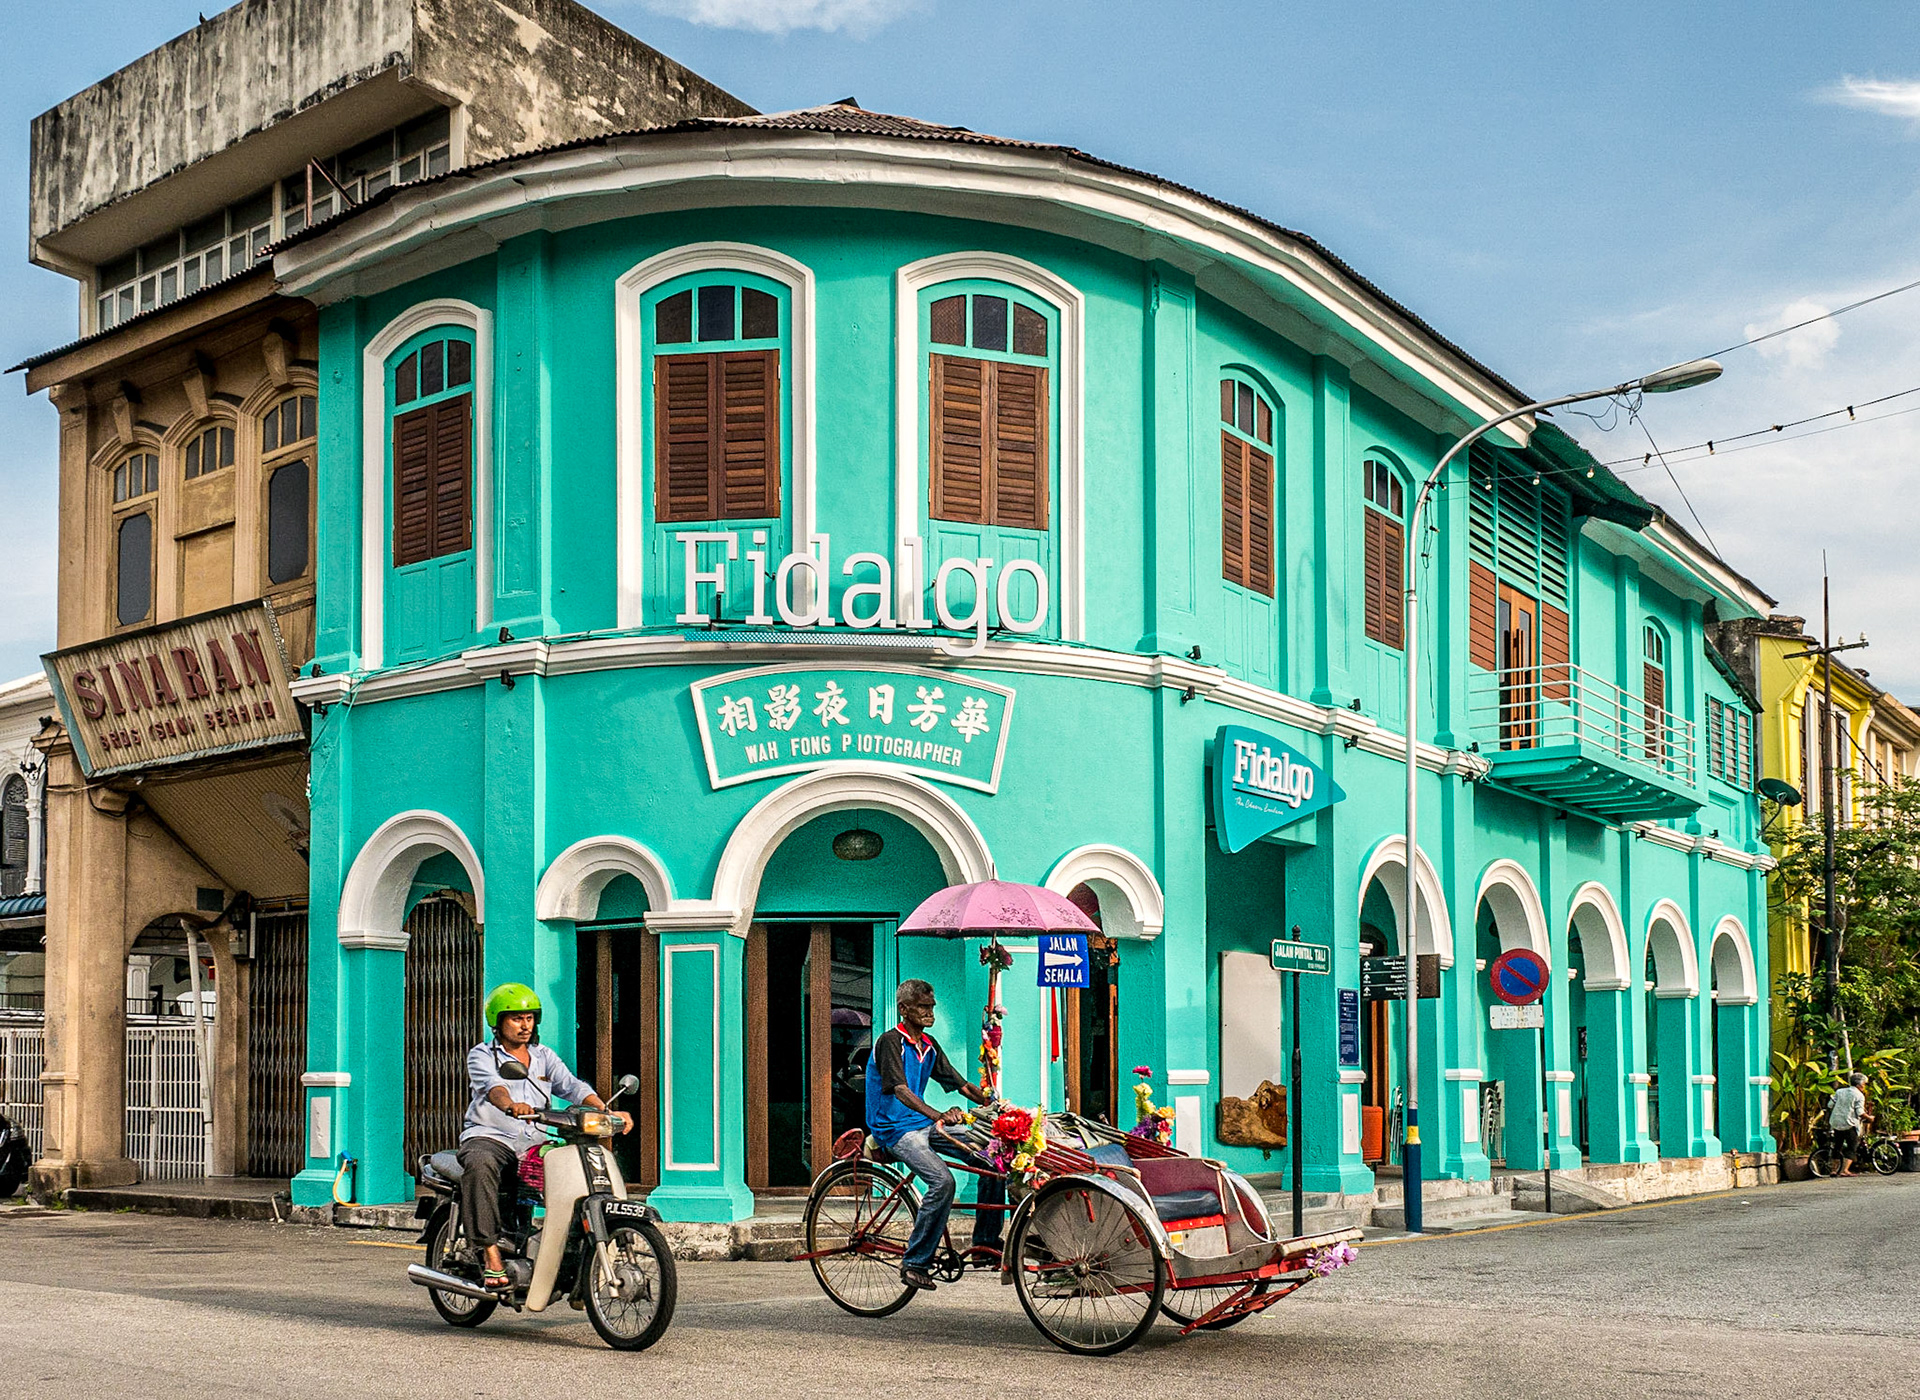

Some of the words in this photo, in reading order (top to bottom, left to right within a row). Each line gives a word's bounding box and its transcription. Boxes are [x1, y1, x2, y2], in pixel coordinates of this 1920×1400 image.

[676, 531, 1049, 657] Fidalgo
[72, 628, 271, 720] SINARAN
[99, 727, 142, 751] BROS
[744, 740, 779, 764] WAH
[790, 735, 832, 757] FONG
[1232, 739, 1314, 809] Fidalgo
[1049, 936, 1078, 952] JALAN
[1275, 944, 1294, 959] JALAN
[1044, 968, 1083, 983] SEHALA
